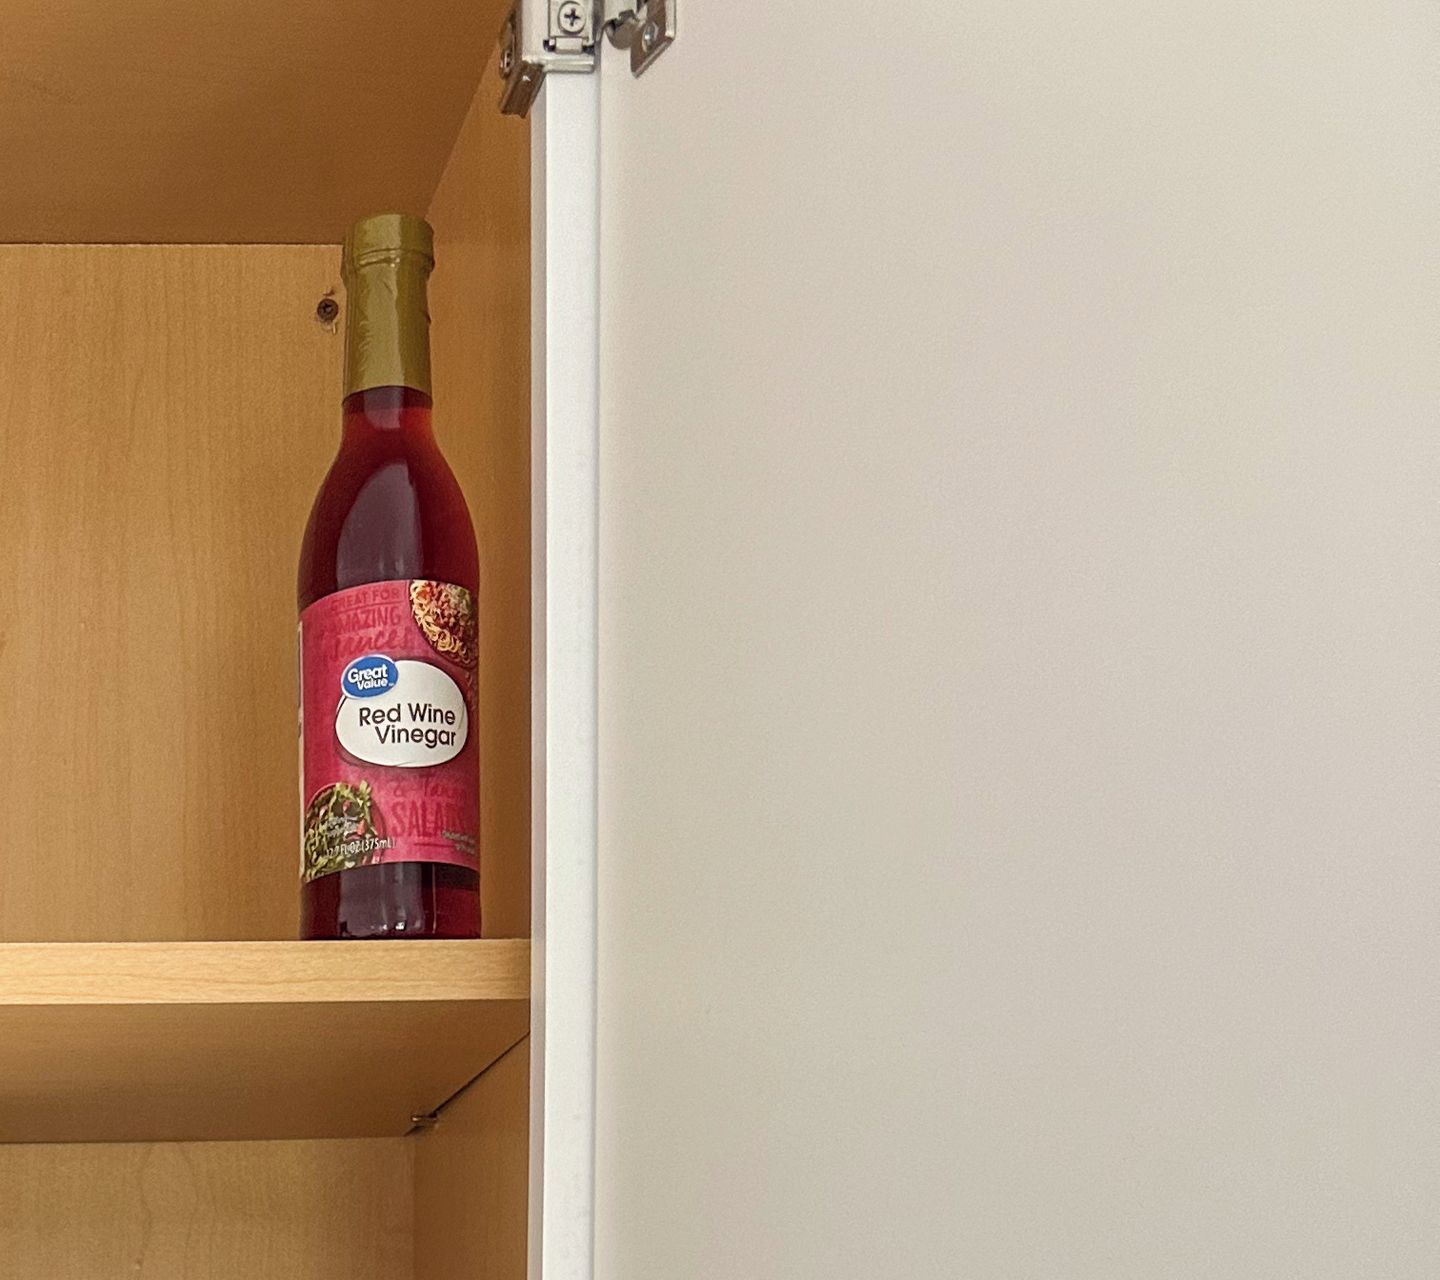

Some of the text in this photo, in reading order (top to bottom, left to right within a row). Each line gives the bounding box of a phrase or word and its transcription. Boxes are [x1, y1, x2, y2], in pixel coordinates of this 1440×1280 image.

[348, 664, 388, 683] Great
[357, 679, 388, 690] Value
[360, 703, 455, 726] Red Wine
[375, 725, 456, 749] Vinegar
